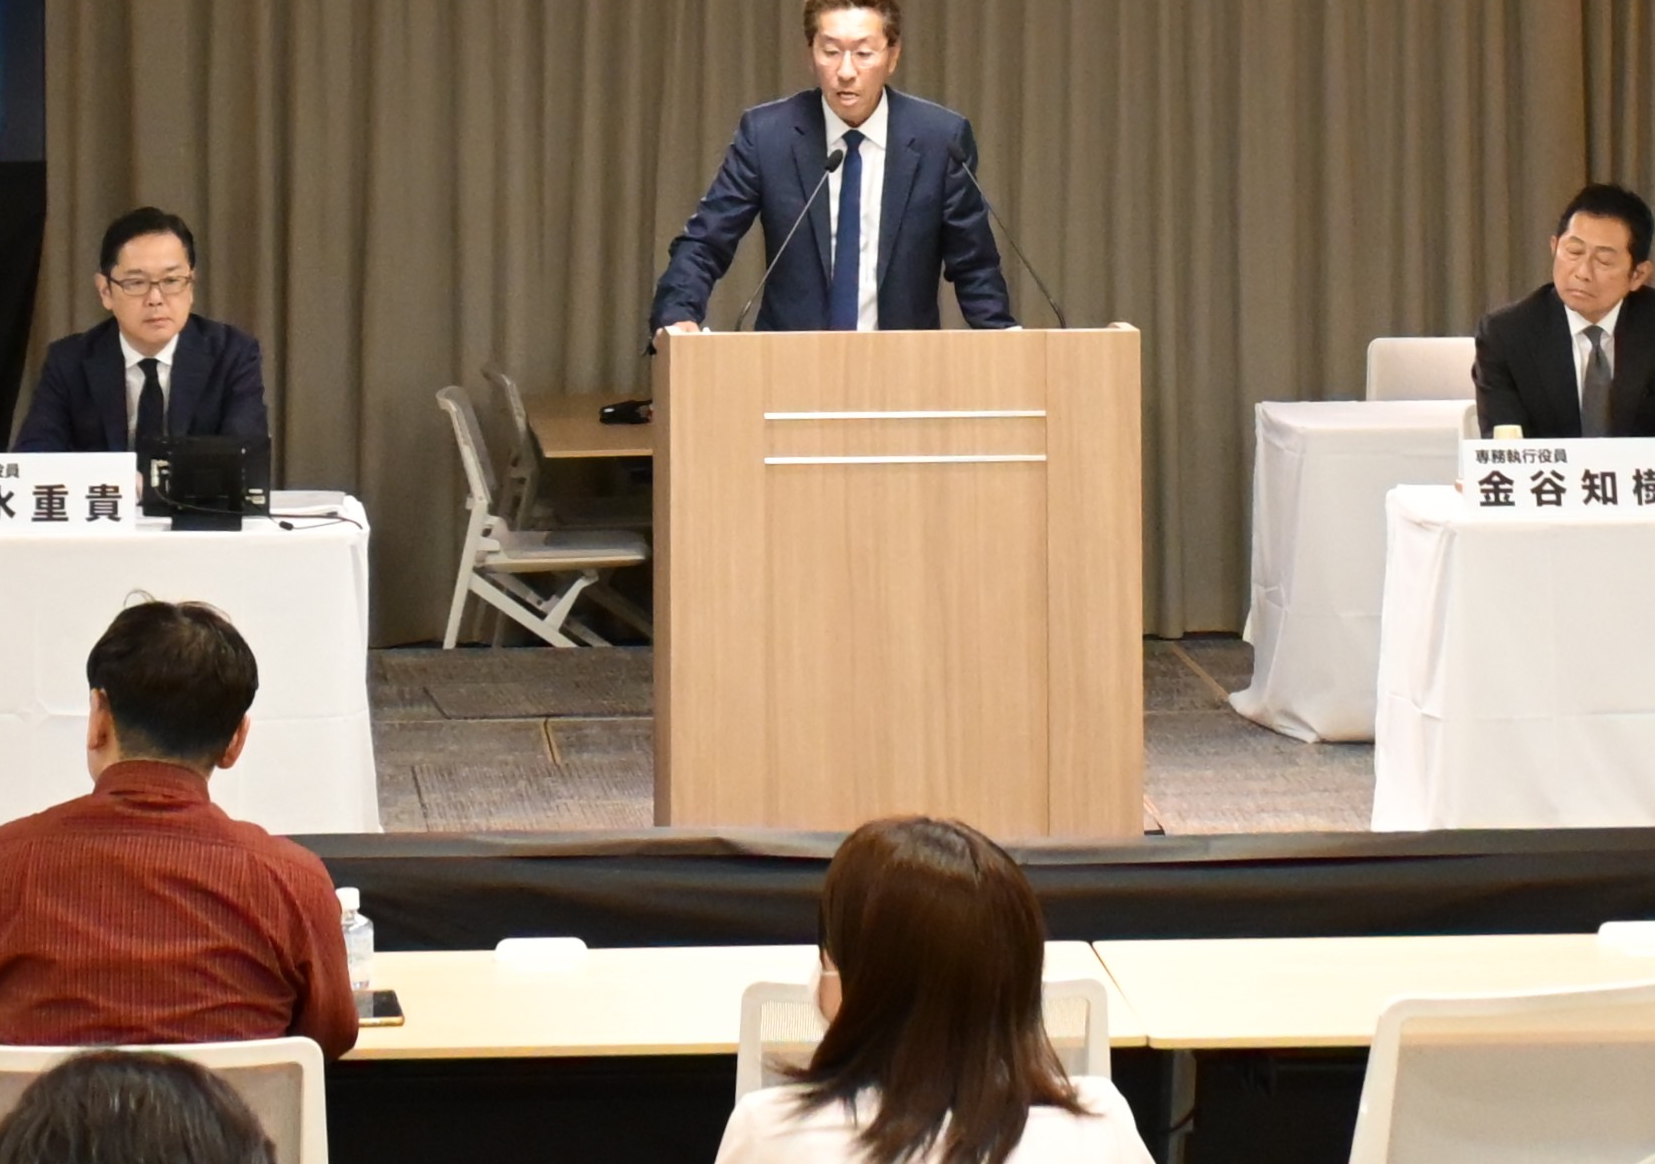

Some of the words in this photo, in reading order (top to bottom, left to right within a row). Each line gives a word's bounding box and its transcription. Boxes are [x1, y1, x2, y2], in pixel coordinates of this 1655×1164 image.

[1475, 448, 1568, 464] 専務執行役員
